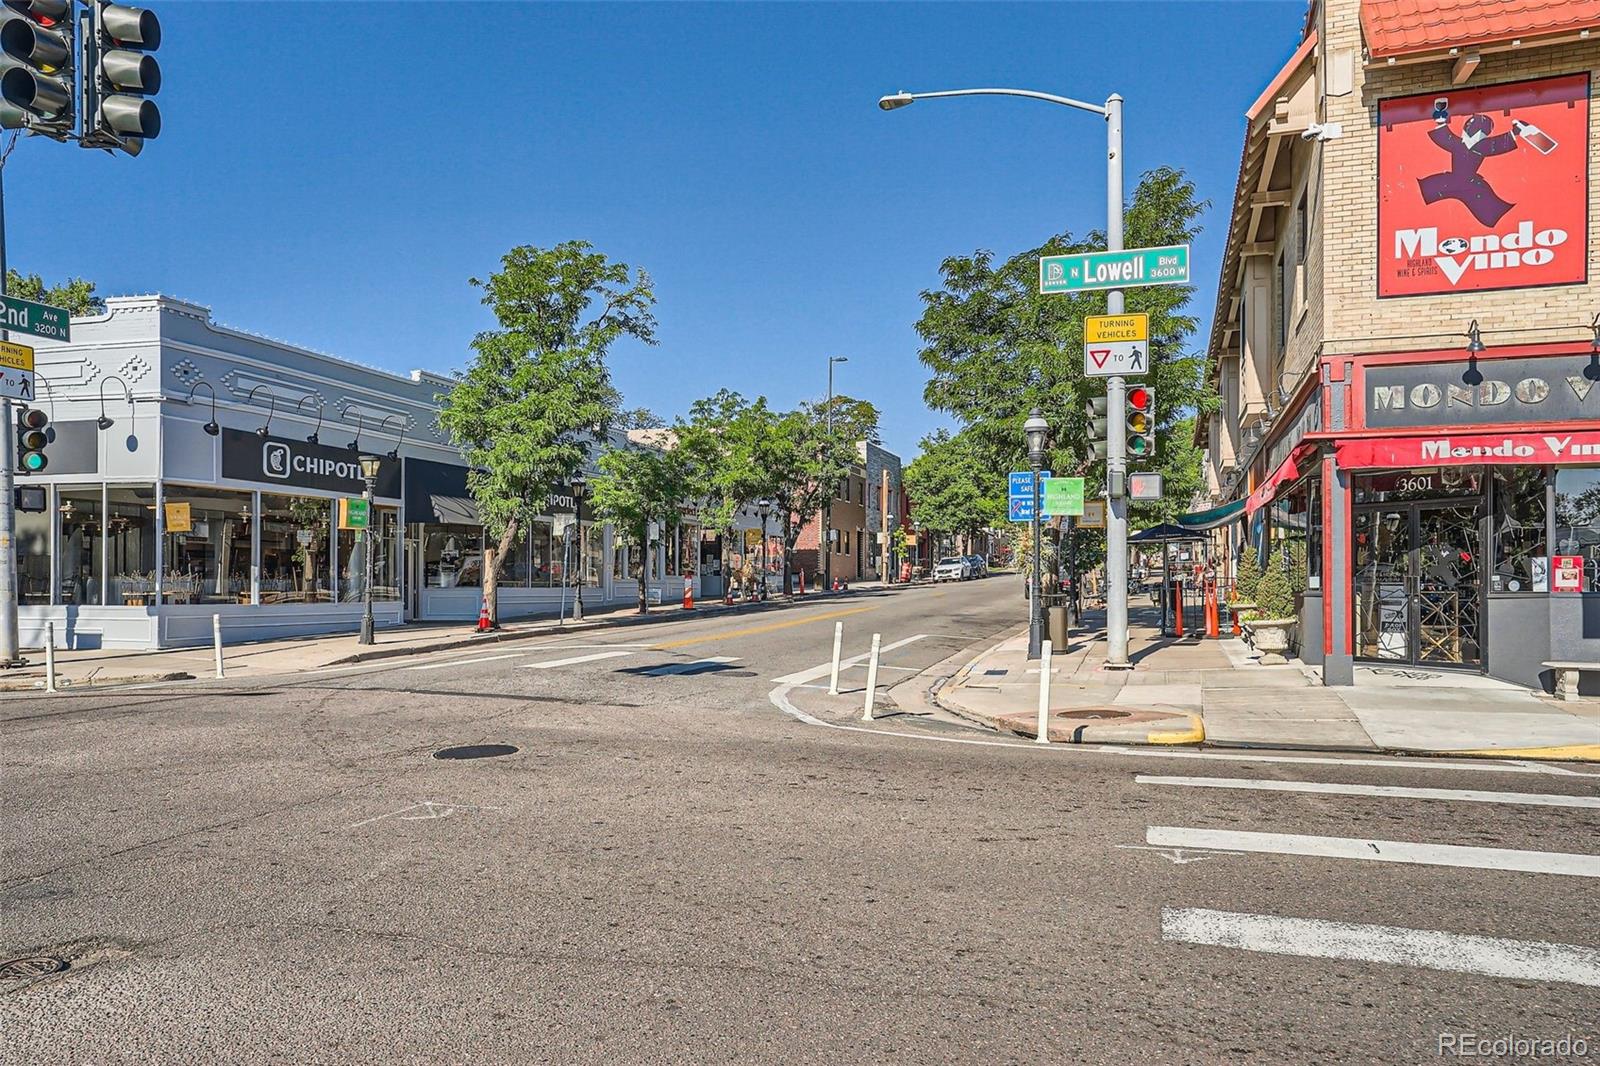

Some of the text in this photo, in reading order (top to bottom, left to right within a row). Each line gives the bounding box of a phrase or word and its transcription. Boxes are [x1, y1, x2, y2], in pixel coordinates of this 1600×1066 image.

[1395, 221, 1568, 259] Mondo
[1159, 256, 1177, 266] Blvd
[1435, 248, 1554, 286] Vino
[1071, 256, 1144, 283] N Lowell
[1151, 266, 1186, 278] 3600 W
[43, 311, 58, 322] Ave
[35, 322, 66, 337] 3200 N
[1099, 320, 1135, 328] TURNING
[1097, 330, 1137, 339] VEHICLES
[1114, 354, 1124, 362] TO
[5, 378, 15, 387] TO
[1374, 378, 1551, 410] MONDO
[1421, 439, 1535, 460] Mondo
[293, 455, 367, 480] CHIPOTL
[1400, 477, 1432, 491] 3601
